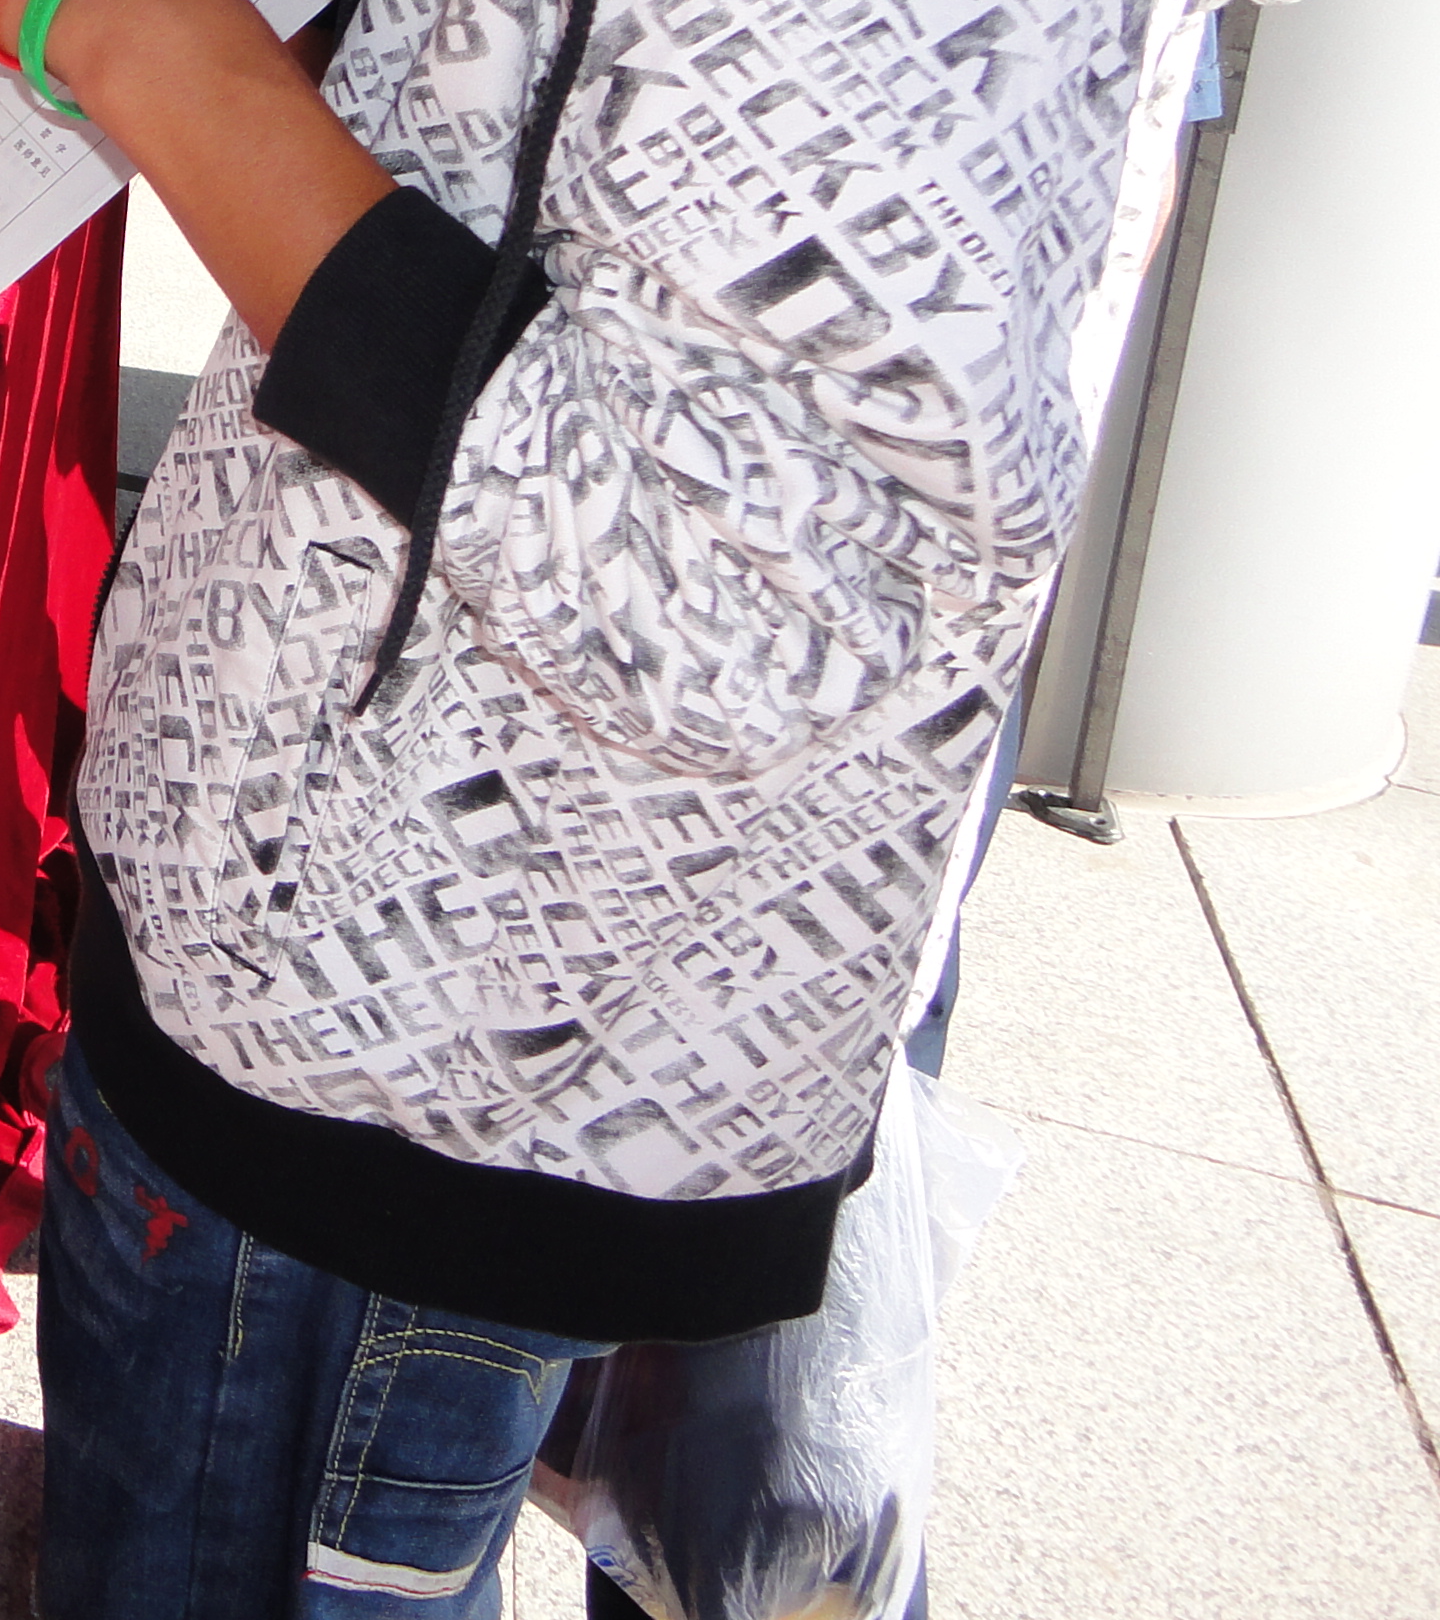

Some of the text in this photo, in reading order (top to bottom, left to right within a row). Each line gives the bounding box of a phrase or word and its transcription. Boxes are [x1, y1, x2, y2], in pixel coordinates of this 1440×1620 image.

[637, 127, 713, 191] BY
[676, 102, 804, 234] DECK
[834, 192, 993, 323] BY
[206, 579, 297, 651] BY
[711, 915, 801, 982] BY
